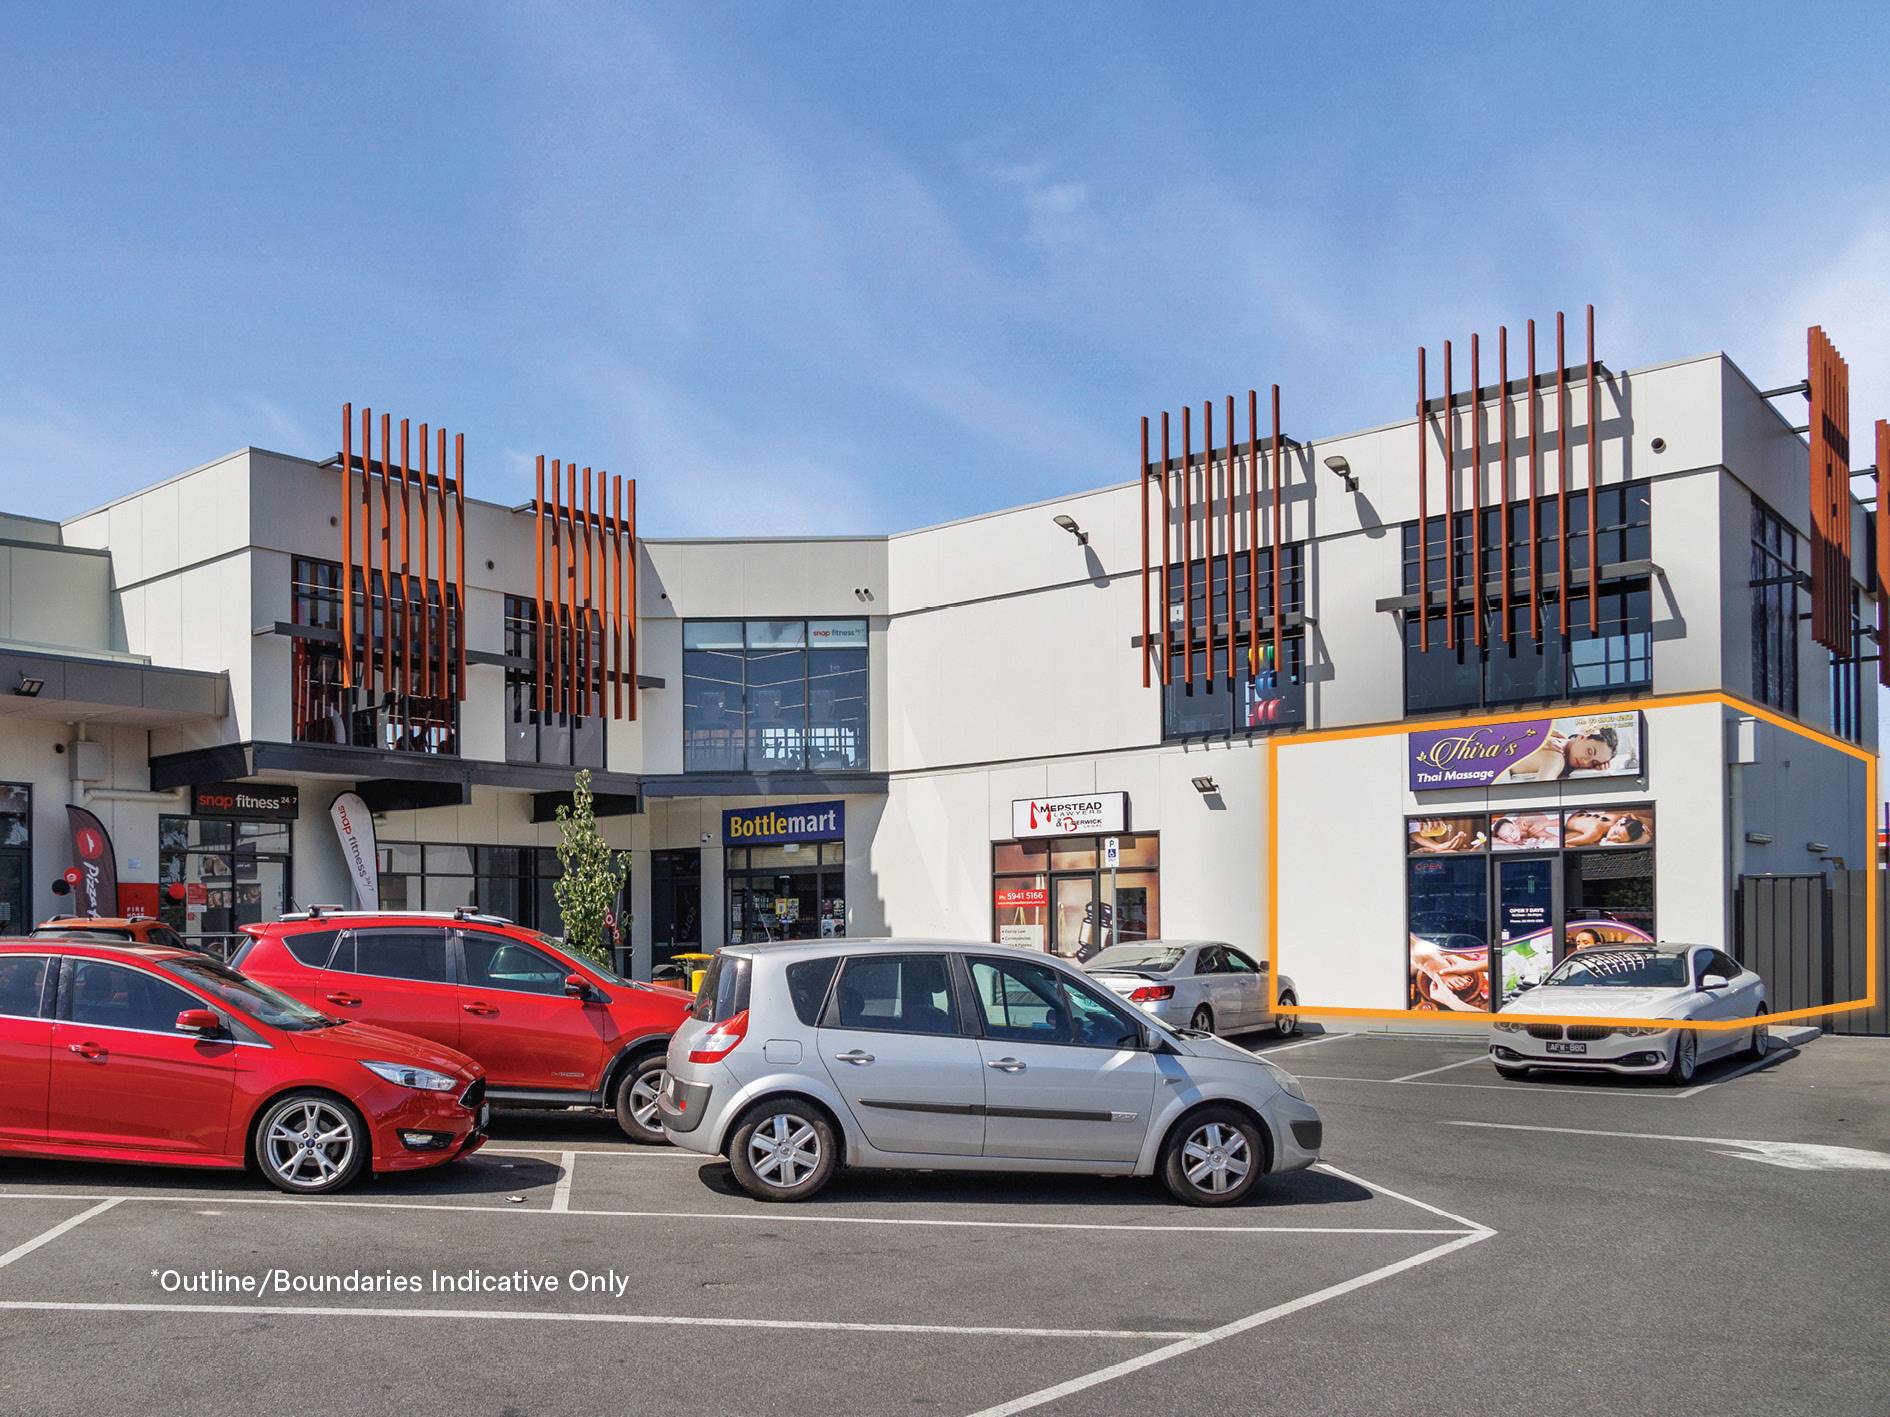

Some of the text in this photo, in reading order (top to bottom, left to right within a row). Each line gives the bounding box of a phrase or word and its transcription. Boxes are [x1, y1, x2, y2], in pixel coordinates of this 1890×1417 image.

[1417, 770, 1495, 783] Thai Massage
[199, 793, 234, 809] snap
[235, 794, 280, 809] fitness
[1040, 802, 1102, 813] MEPSTEAD
[1053, 810, 1102, 818] LAWYERS
[730, 809, 836, 838] Bottlemart
[337, 804, 352, 835] snap
[348, 835, 367, 878] fitness
[83, 861, 100, 908] Pizza
[1007, 892, 1024, 900] 5941
[1025, 891, 1044, 900] 5166
